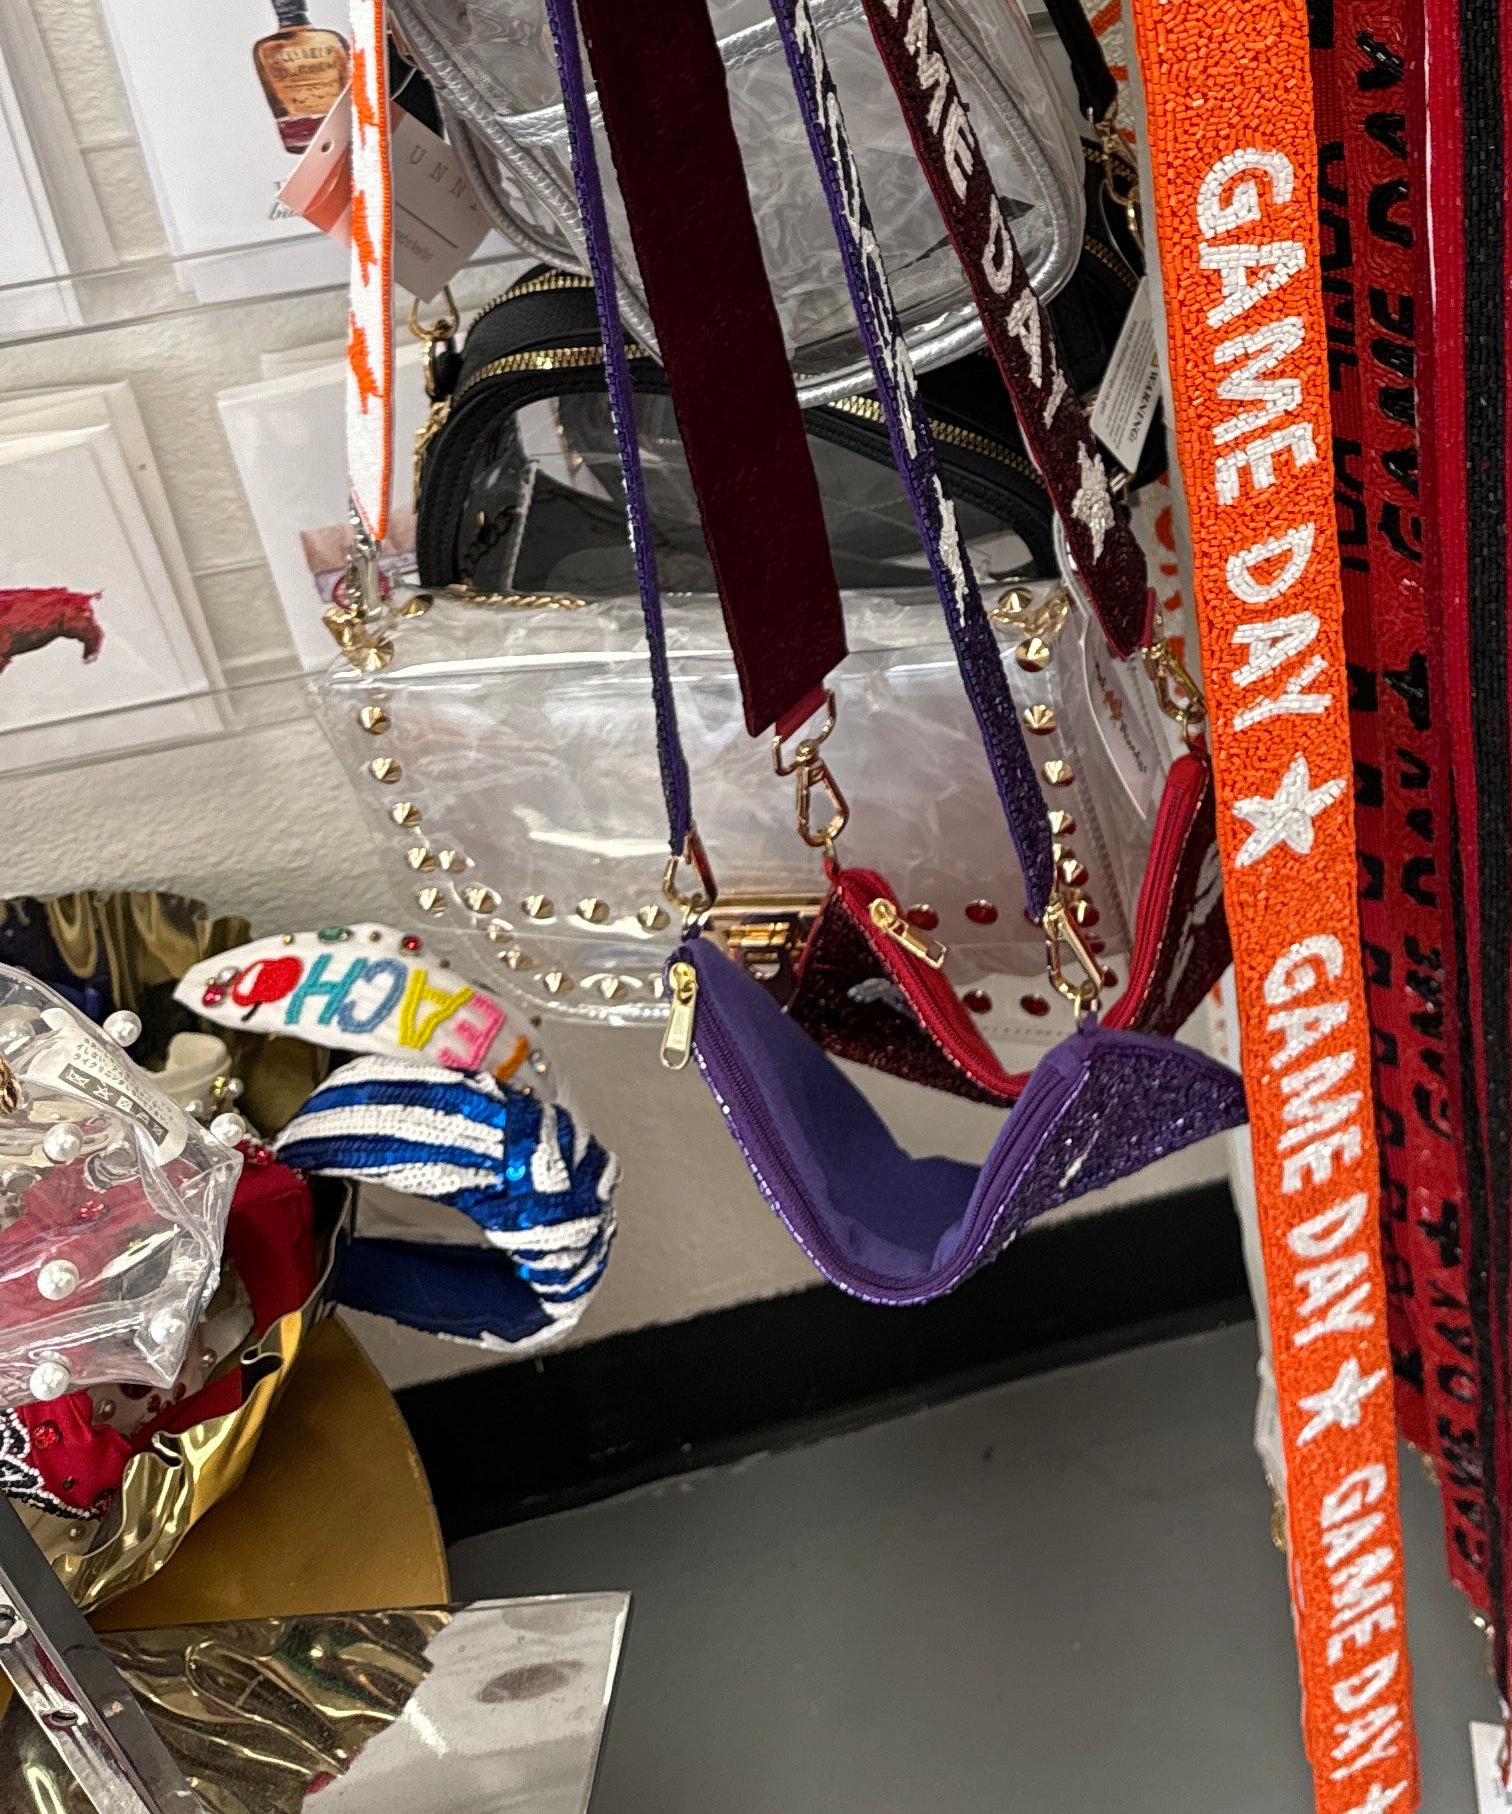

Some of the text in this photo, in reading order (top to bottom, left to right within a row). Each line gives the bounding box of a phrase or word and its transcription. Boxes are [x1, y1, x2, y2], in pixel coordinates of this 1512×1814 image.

[981, 194, 1068, 430] DAY
[1196, 147, 1333, 733] GAME DAY
[1264, 933, 1375, 1348] GAME DAY
[1320, 1461, 1403, 1782] GAME DAY
